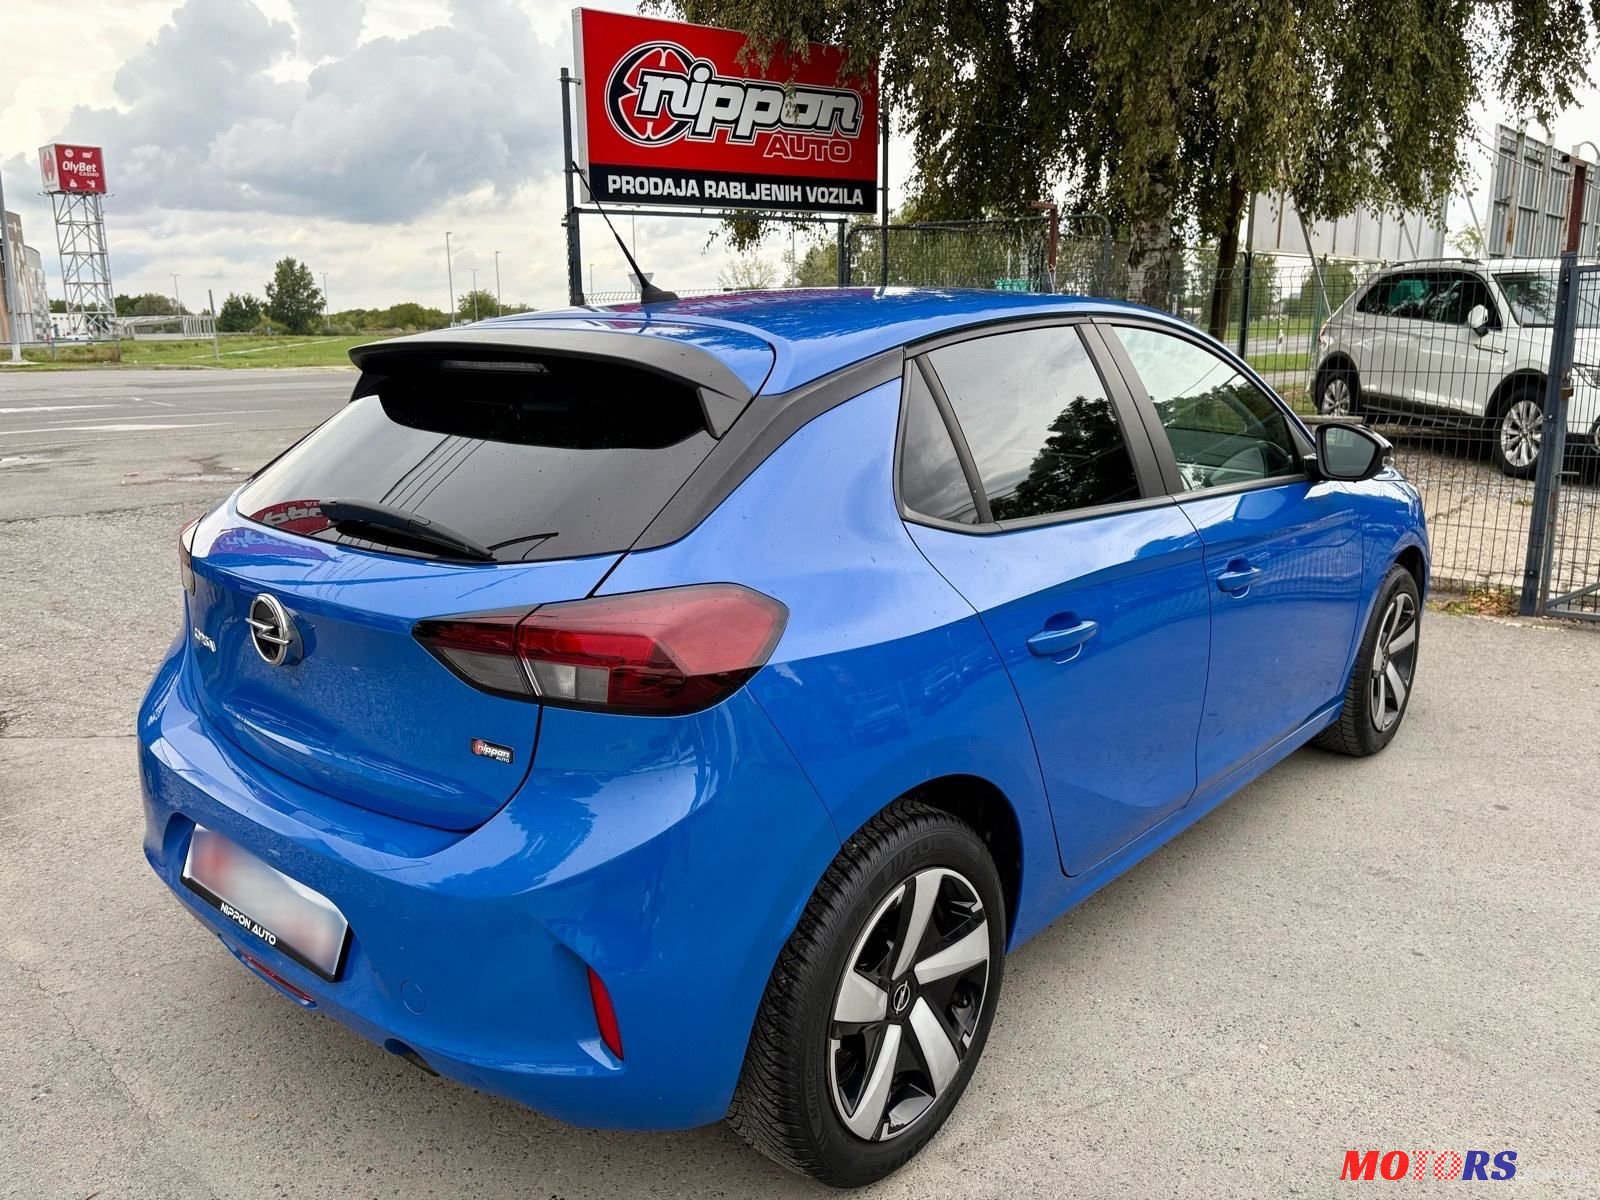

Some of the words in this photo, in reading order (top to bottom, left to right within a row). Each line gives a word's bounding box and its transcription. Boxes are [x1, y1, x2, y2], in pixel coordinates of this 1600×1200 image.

[636, 60, 862, 142] nippon
[763, 134, 852, 163] AUTO
[62, 160, 97, 174] OlyBet
[608, 174, 700, 197] PRODAJA
[704, 180, 802, 203] RABLJENIH
[805, 186, 864, 206] VOZILA
[477, 743, 511, 758] nippon
[220, 902, 252, 930] NIPPON
[251, 924, 277, 946] AUTO
